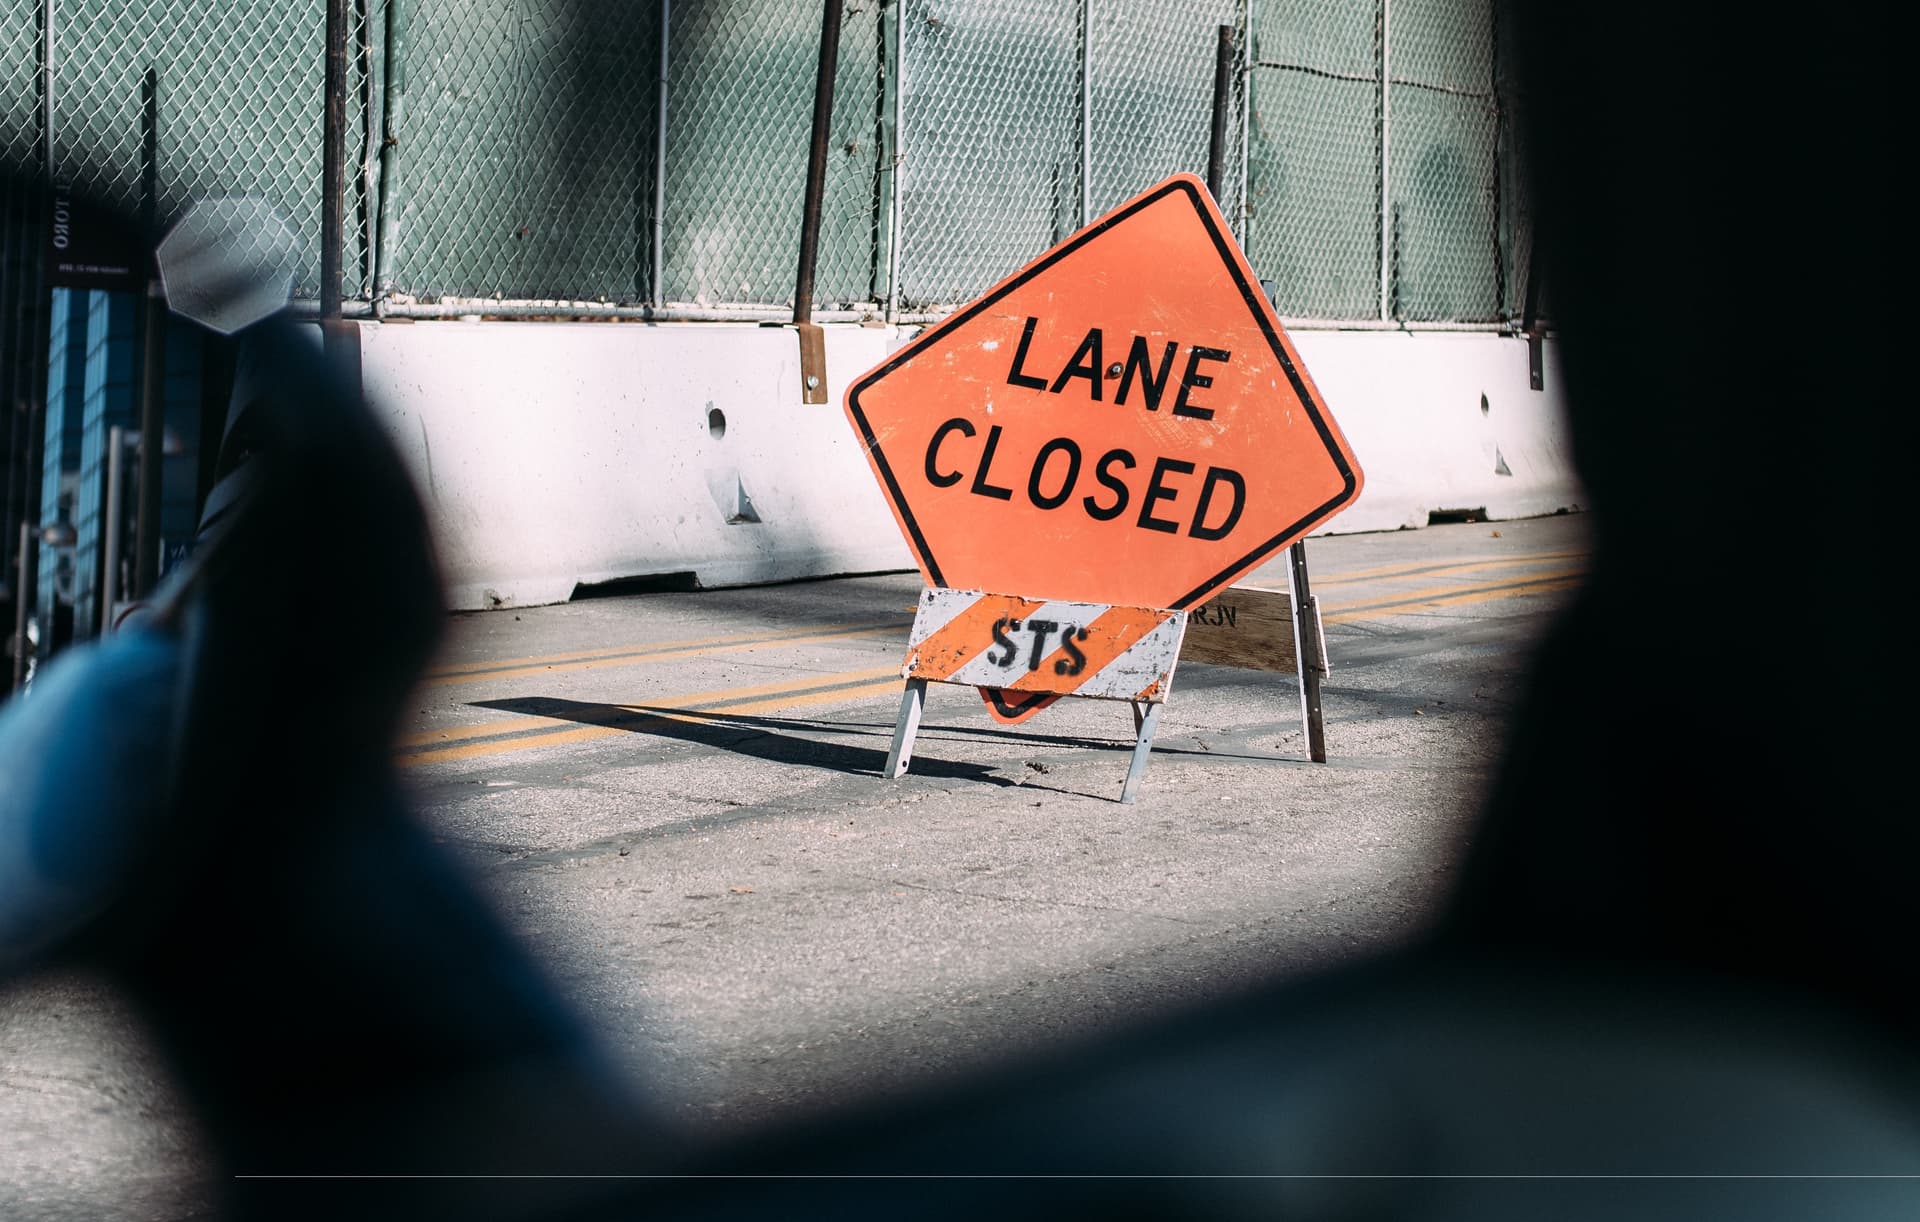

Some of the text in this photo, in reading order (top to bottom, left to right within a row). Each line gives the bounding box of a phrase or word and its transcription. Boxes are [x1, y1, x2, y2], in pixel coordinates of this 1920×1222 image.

[1006, 316, 1231, 421] LANE
[924, 417, 1246, 541] CLOSED
[987, 617, 1088, 676] STS
[1187, 603, 1237, 628] RJV
